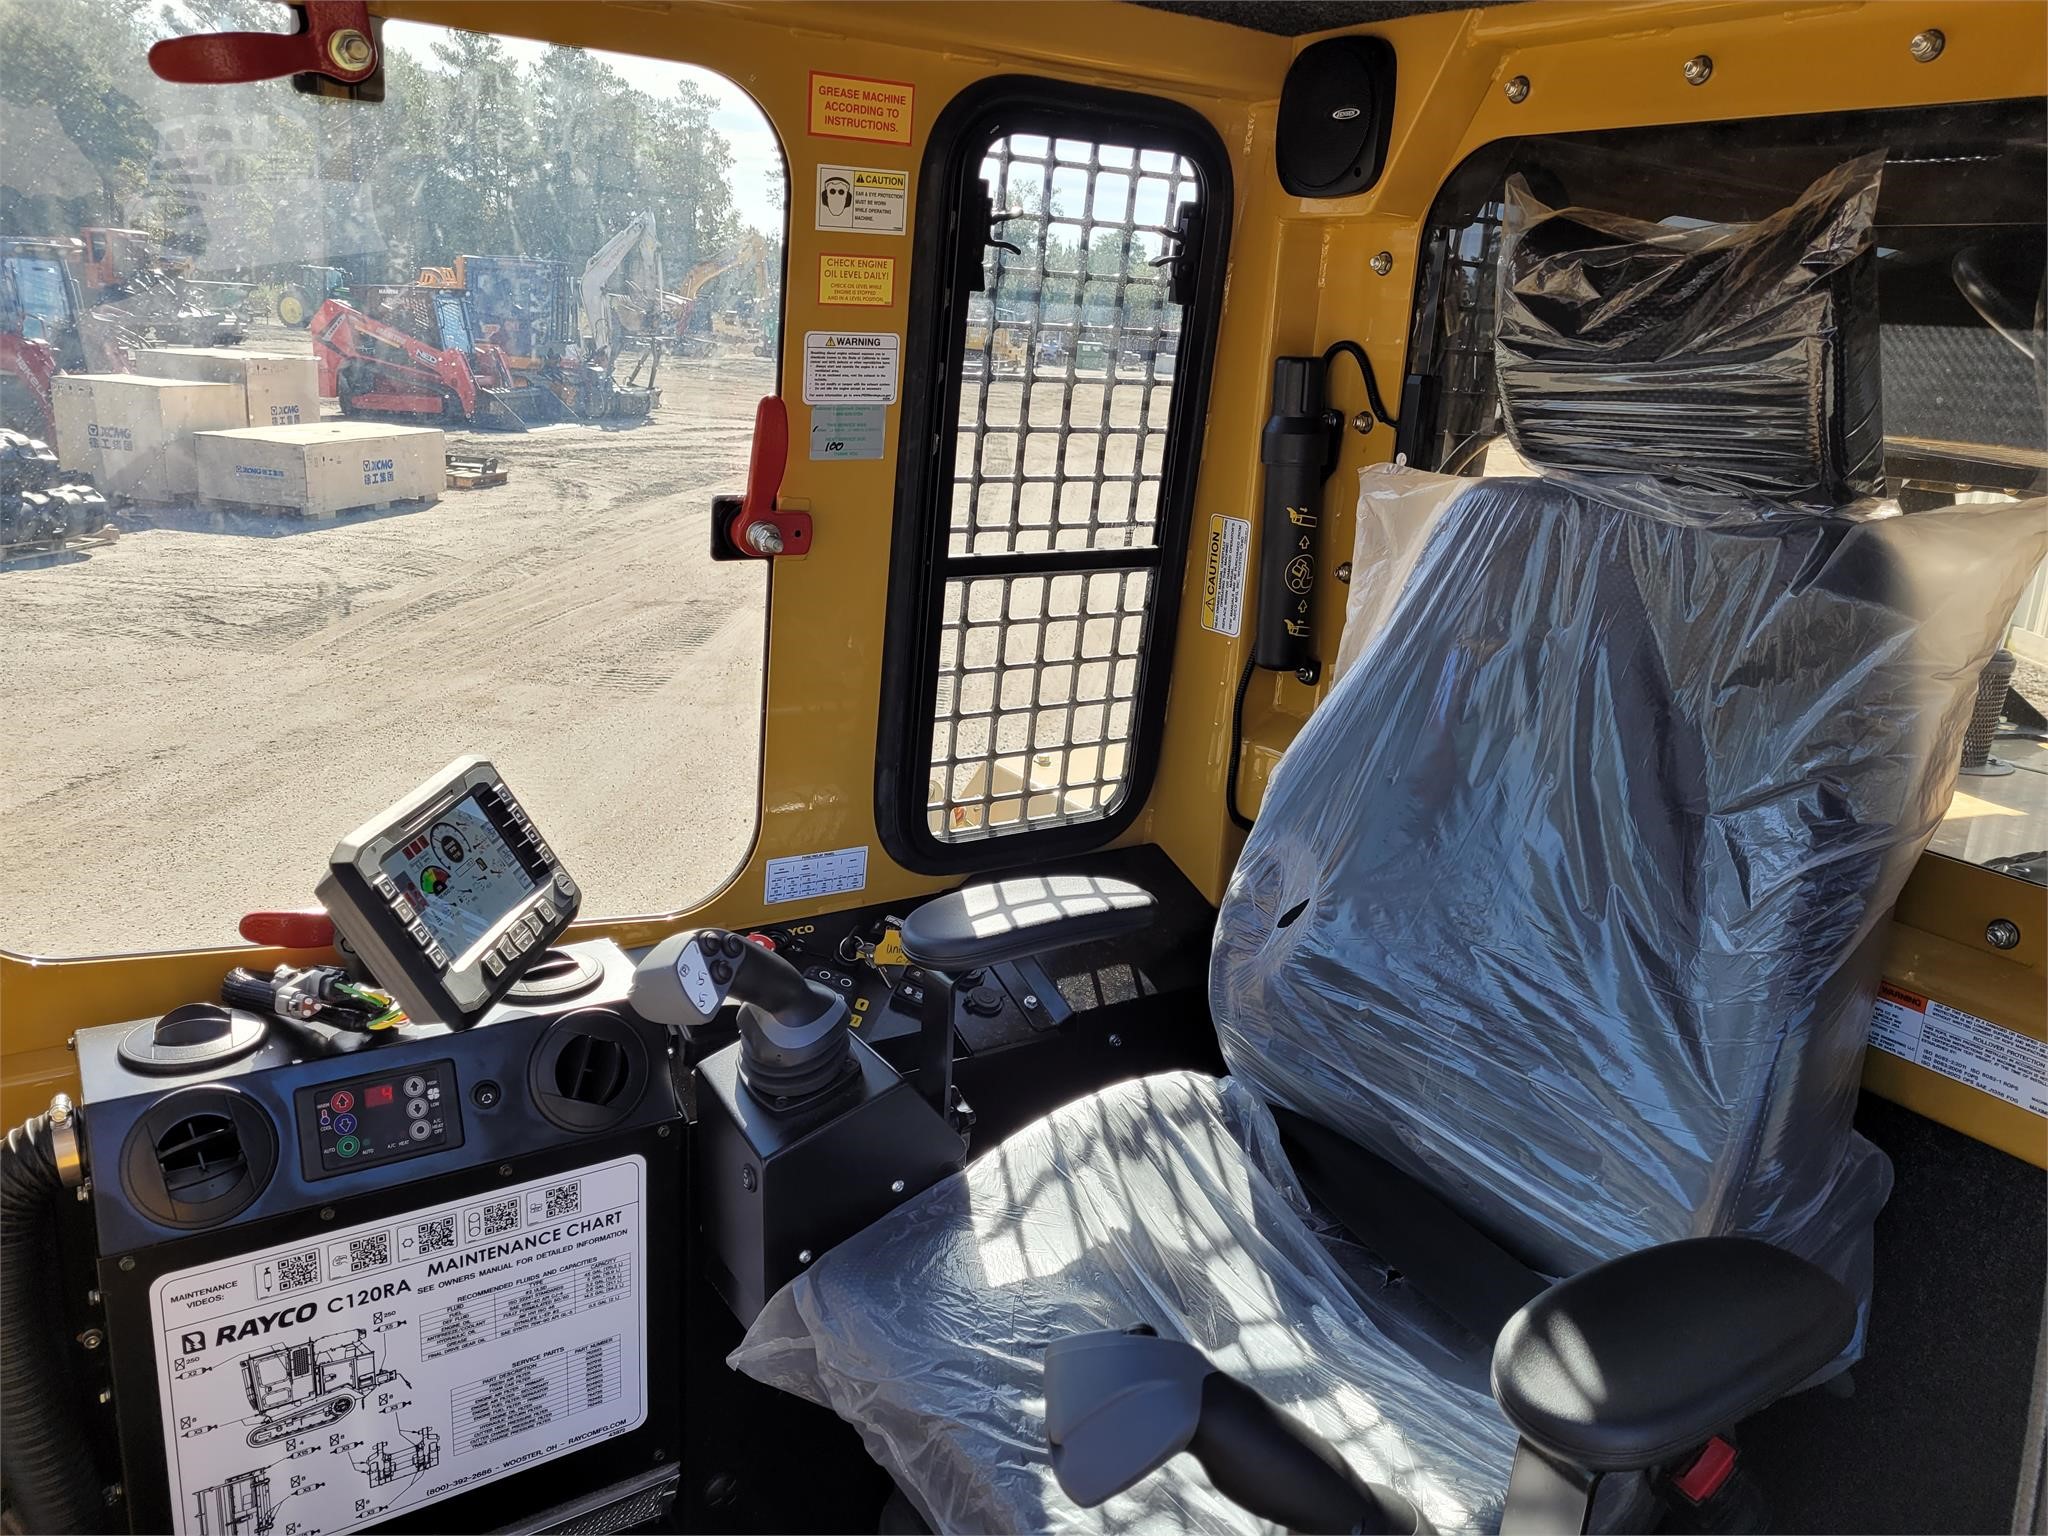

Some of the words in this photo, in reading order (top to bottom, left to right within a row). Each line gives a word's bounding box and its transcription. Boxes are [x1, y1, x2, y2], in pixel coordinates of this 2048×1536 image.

[819, 86, 860, 99] GREASE
[862, 91, 906, 105] MACHINE
[825, 101, 884, 116] ACCORDING
[887, 109, 899, 118] TO
[825, 116, 898, 132] INSTRUCTIONS.
[866, 176, 903, 186] CAUTION
[827, 258, 855, 267] CHECK
[858, 260, 887, 269] ENGINE
[840, 271, 861, 279] LEVEL
[864, 272, 888, 280] DAILY!
[837, 338, 880, 346] WARNING
[279, 405, 298, 414] XCMG
[100, 426, 131, 439] XCMG
[825, 442, 843, 452] 100
[371, 460, 393, 471] XCMG
[1208, 531, 1220, 596] CAUTION
[788, 925, 814, 936] YCO
[1973, 1036, 2004, 1052] ROLLOVER
[2007, 1049, 2045, 1069] PROTECTION
[1970, 1068, 1980, 1076] ISO
[427, 1228, 561, 1277] MAINTENANCE
[567, 1211, 622, 1238] CHART
[418, 1284, 434, 1295] SEE
[438, 1272, 475, 1289] OWNERS
[479, 1262, 513, 1277] MANUAL
[516, 1256, 533, 1266] FOR
[536, 1244, 573, 1260] DETAILED
[576, 1228, 628, 1248] INFORMATION
[457, 1281, 513, 1303] RECOMMENDED
[516, 1273, 540, 1286] FLUIDS
[543, 1268, 557, 1277] AND
[560, 1256, 597, 1272] CAPACITIES
[170, 1280, 238, 1304] MAINTENANCE
[186, 1293, 225, 1310] VIDEOS:
[214, 1300, 318, 1347] RAYCO
[327, 1277, 412, 1315] C120RA
[512, 1354, 541, 1368] SERVICE
[544, 1346, 564, 1358] PARTS
[426, 1467, 492, 1497] (800)-392-2686
[546, 1444, 557, 1453] OH
[569, 1419, 626, 1445] RAYCOMFG.COM
